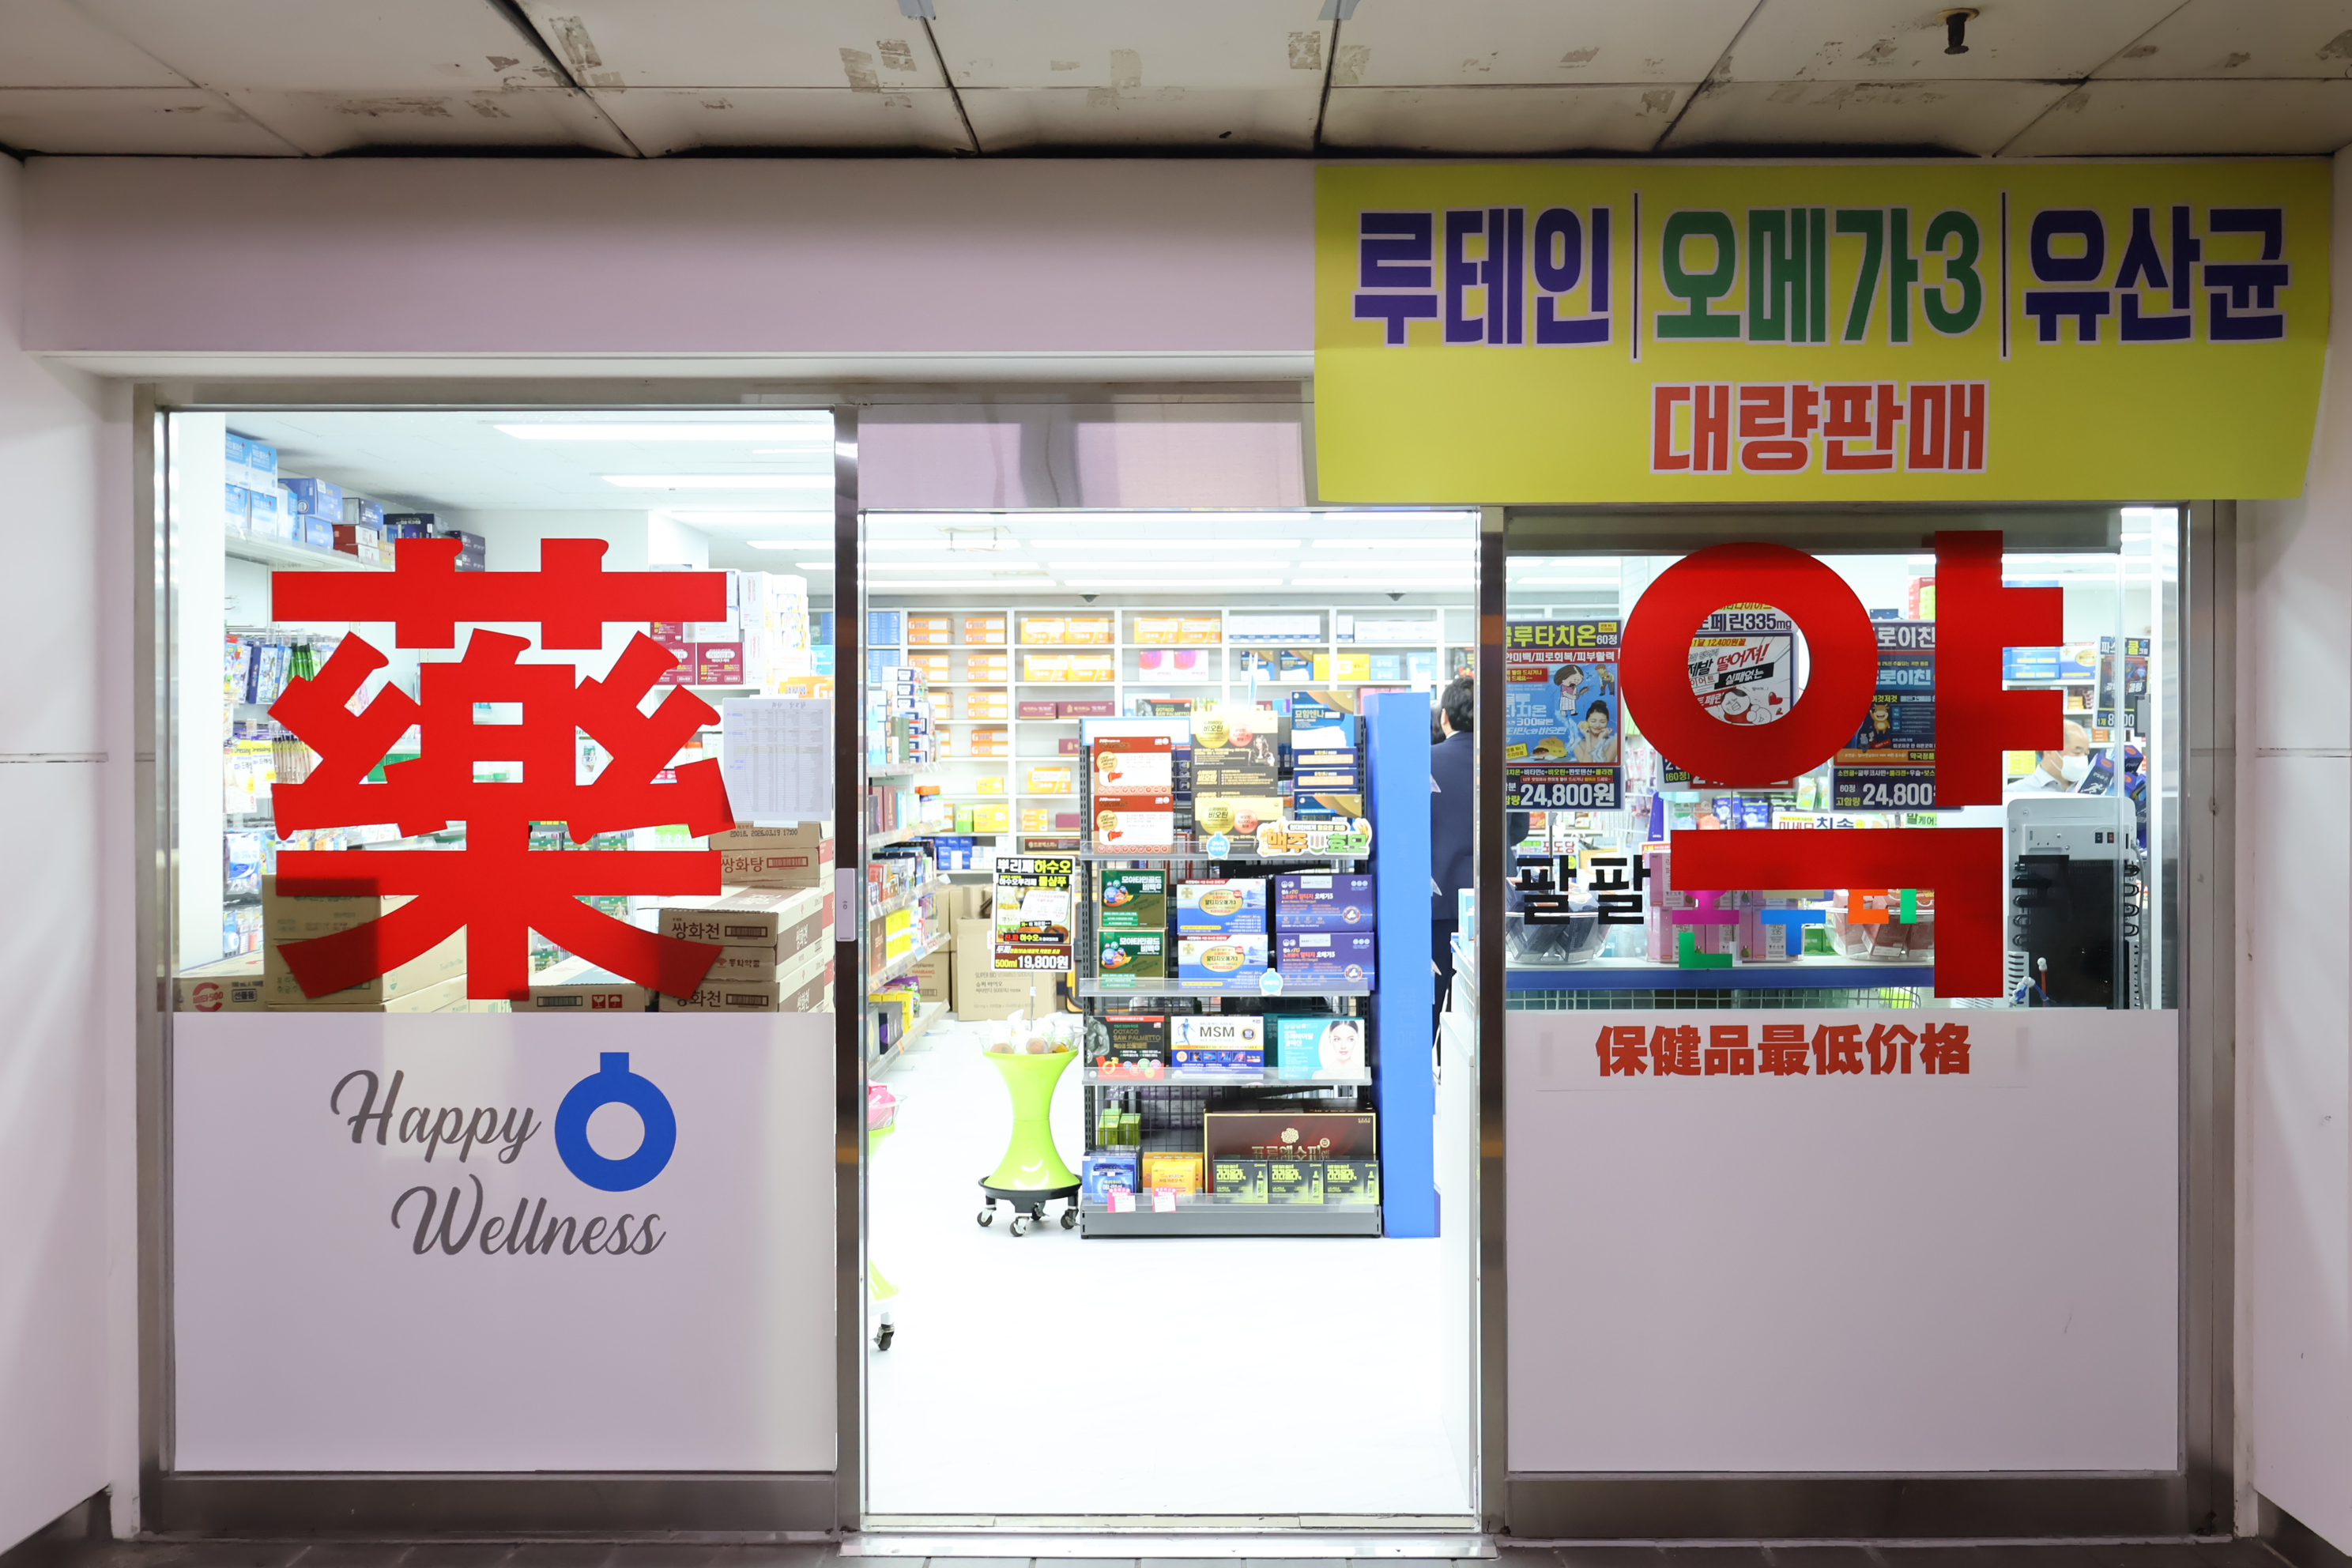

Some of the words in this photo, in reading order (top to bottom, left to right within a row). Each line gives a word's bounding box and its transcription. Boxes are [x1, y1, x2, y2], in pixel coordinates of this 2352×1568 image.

[1354, 206, 1611, 345] 루테인
[1654, 206, 1982, 344] 오메가3
[2023, 205, 2290, 343] 유산균
[1652, 382, 1987, 472] 대량판매
[1596, 635, 1618, 645] 60정
[1874, 627, 1936, 648] 로이친
[1717, 643, 1770, 673] 떨어져!
[1725, 668, 1764, 686] 실패없는
[1876, 669, 1931, 685] 로이친
[268, 538, 737, 1000] 藥
[1619, 530, 2064, 998] 약
[1521, 782, 1615, 807] 24,800원
[1839, 784, 1856, 793] 60정
[1863, 782, 1936, 807] 24,800
[1267, 832, 1309, 854] 맥주
[1326, 832, 1367, 854] 효모
[722, 856, 764, 874] 쌍화탕
[1515, 854, 1651, 925] 팔팔
[672, 922, 721, 940] 쌍화천
[995, 959, 1017, 968] 500ml
[1018, 955, 1069, 969] 19,800원
[1200, 1026, 1235, 1038] MSM
[1595, 1023, 1972, 1076] 保健品最低价格
[330, 1069, 541, 1164] Happy
[390, 1173, 666, 1255] Wellness
